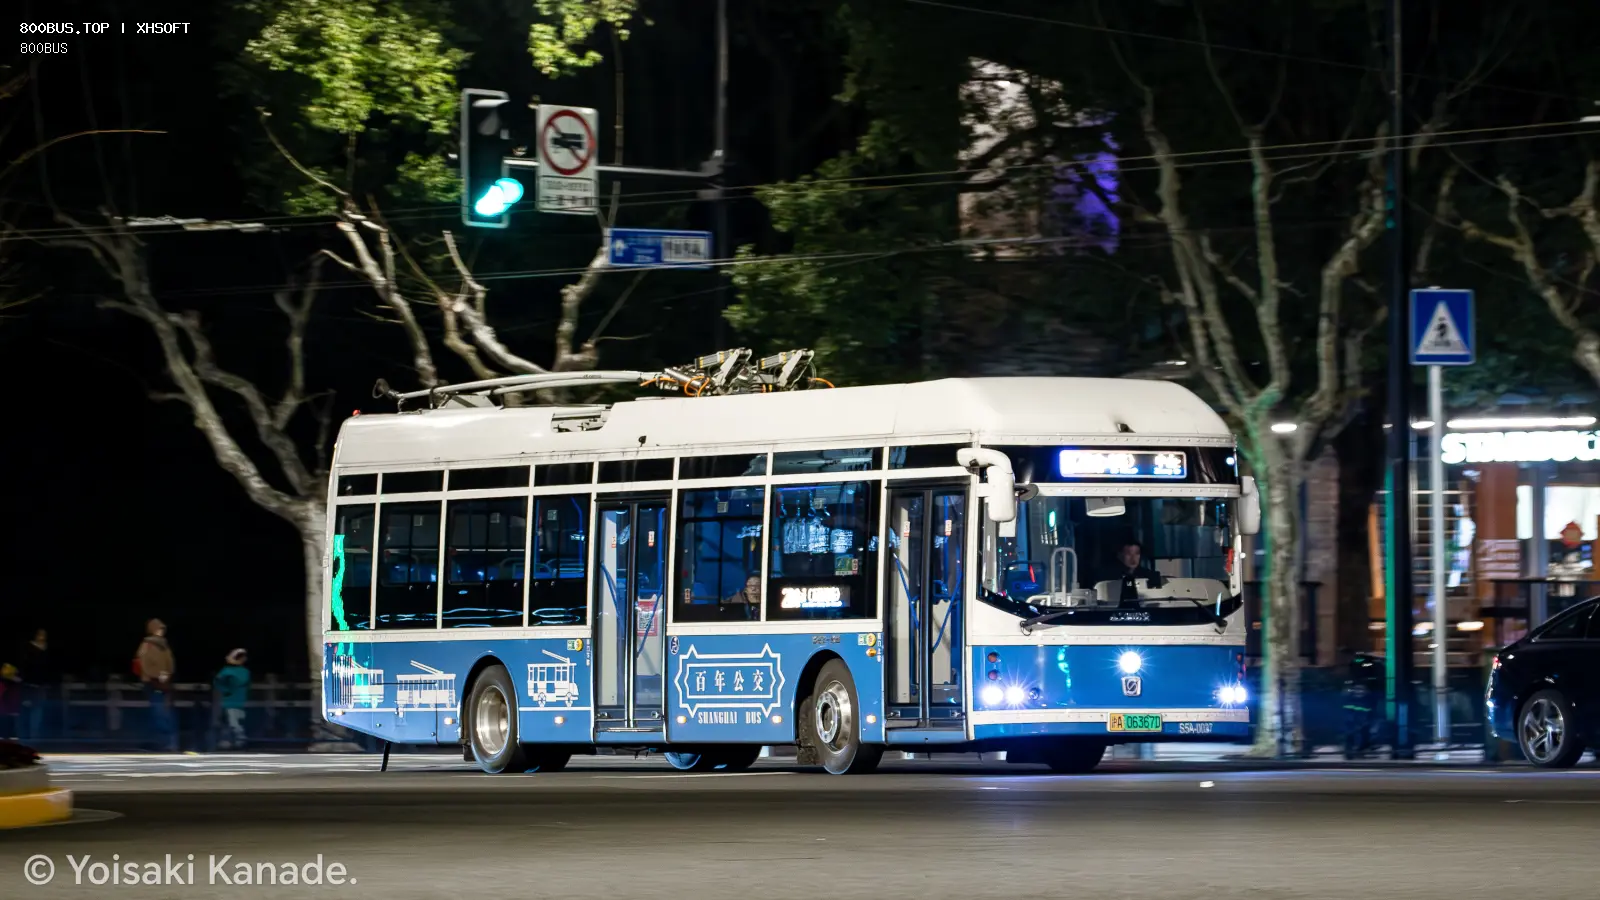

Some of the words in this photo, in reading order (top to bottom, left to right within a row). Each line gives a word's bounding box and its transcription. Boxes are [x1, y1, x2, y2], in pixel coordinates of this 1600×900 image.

[695, 669, 764, 692] 百年公交
[698, 711, 738, 724] SHANGHAI
[745, 711, 762, 724] BUS
